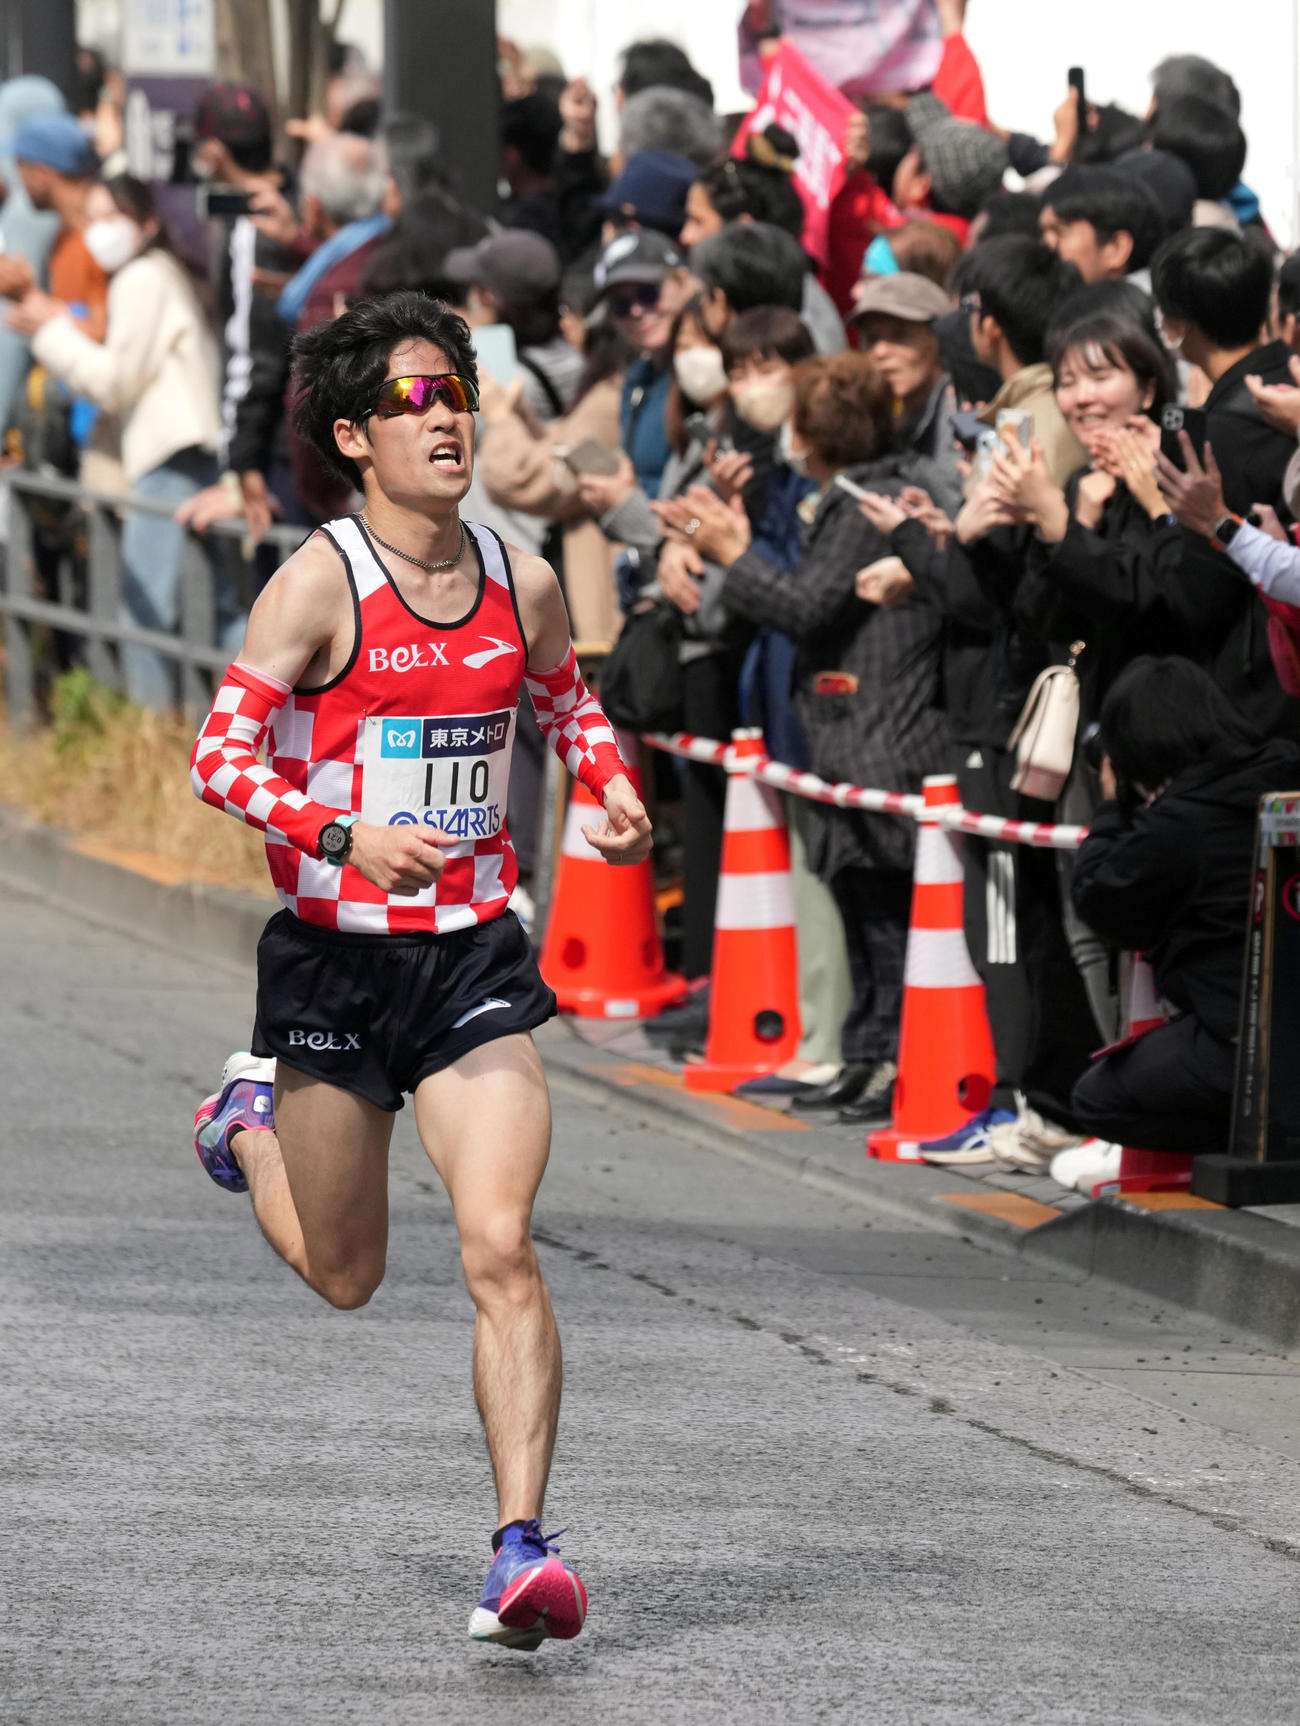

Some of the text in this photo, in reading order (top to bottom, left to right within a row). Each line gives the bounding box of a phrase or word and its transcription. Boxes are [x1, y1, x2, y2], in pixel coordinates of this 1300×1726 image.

[430, 722, 505, 748] 東京メトロ
[424, 760, 489, 806] 110
